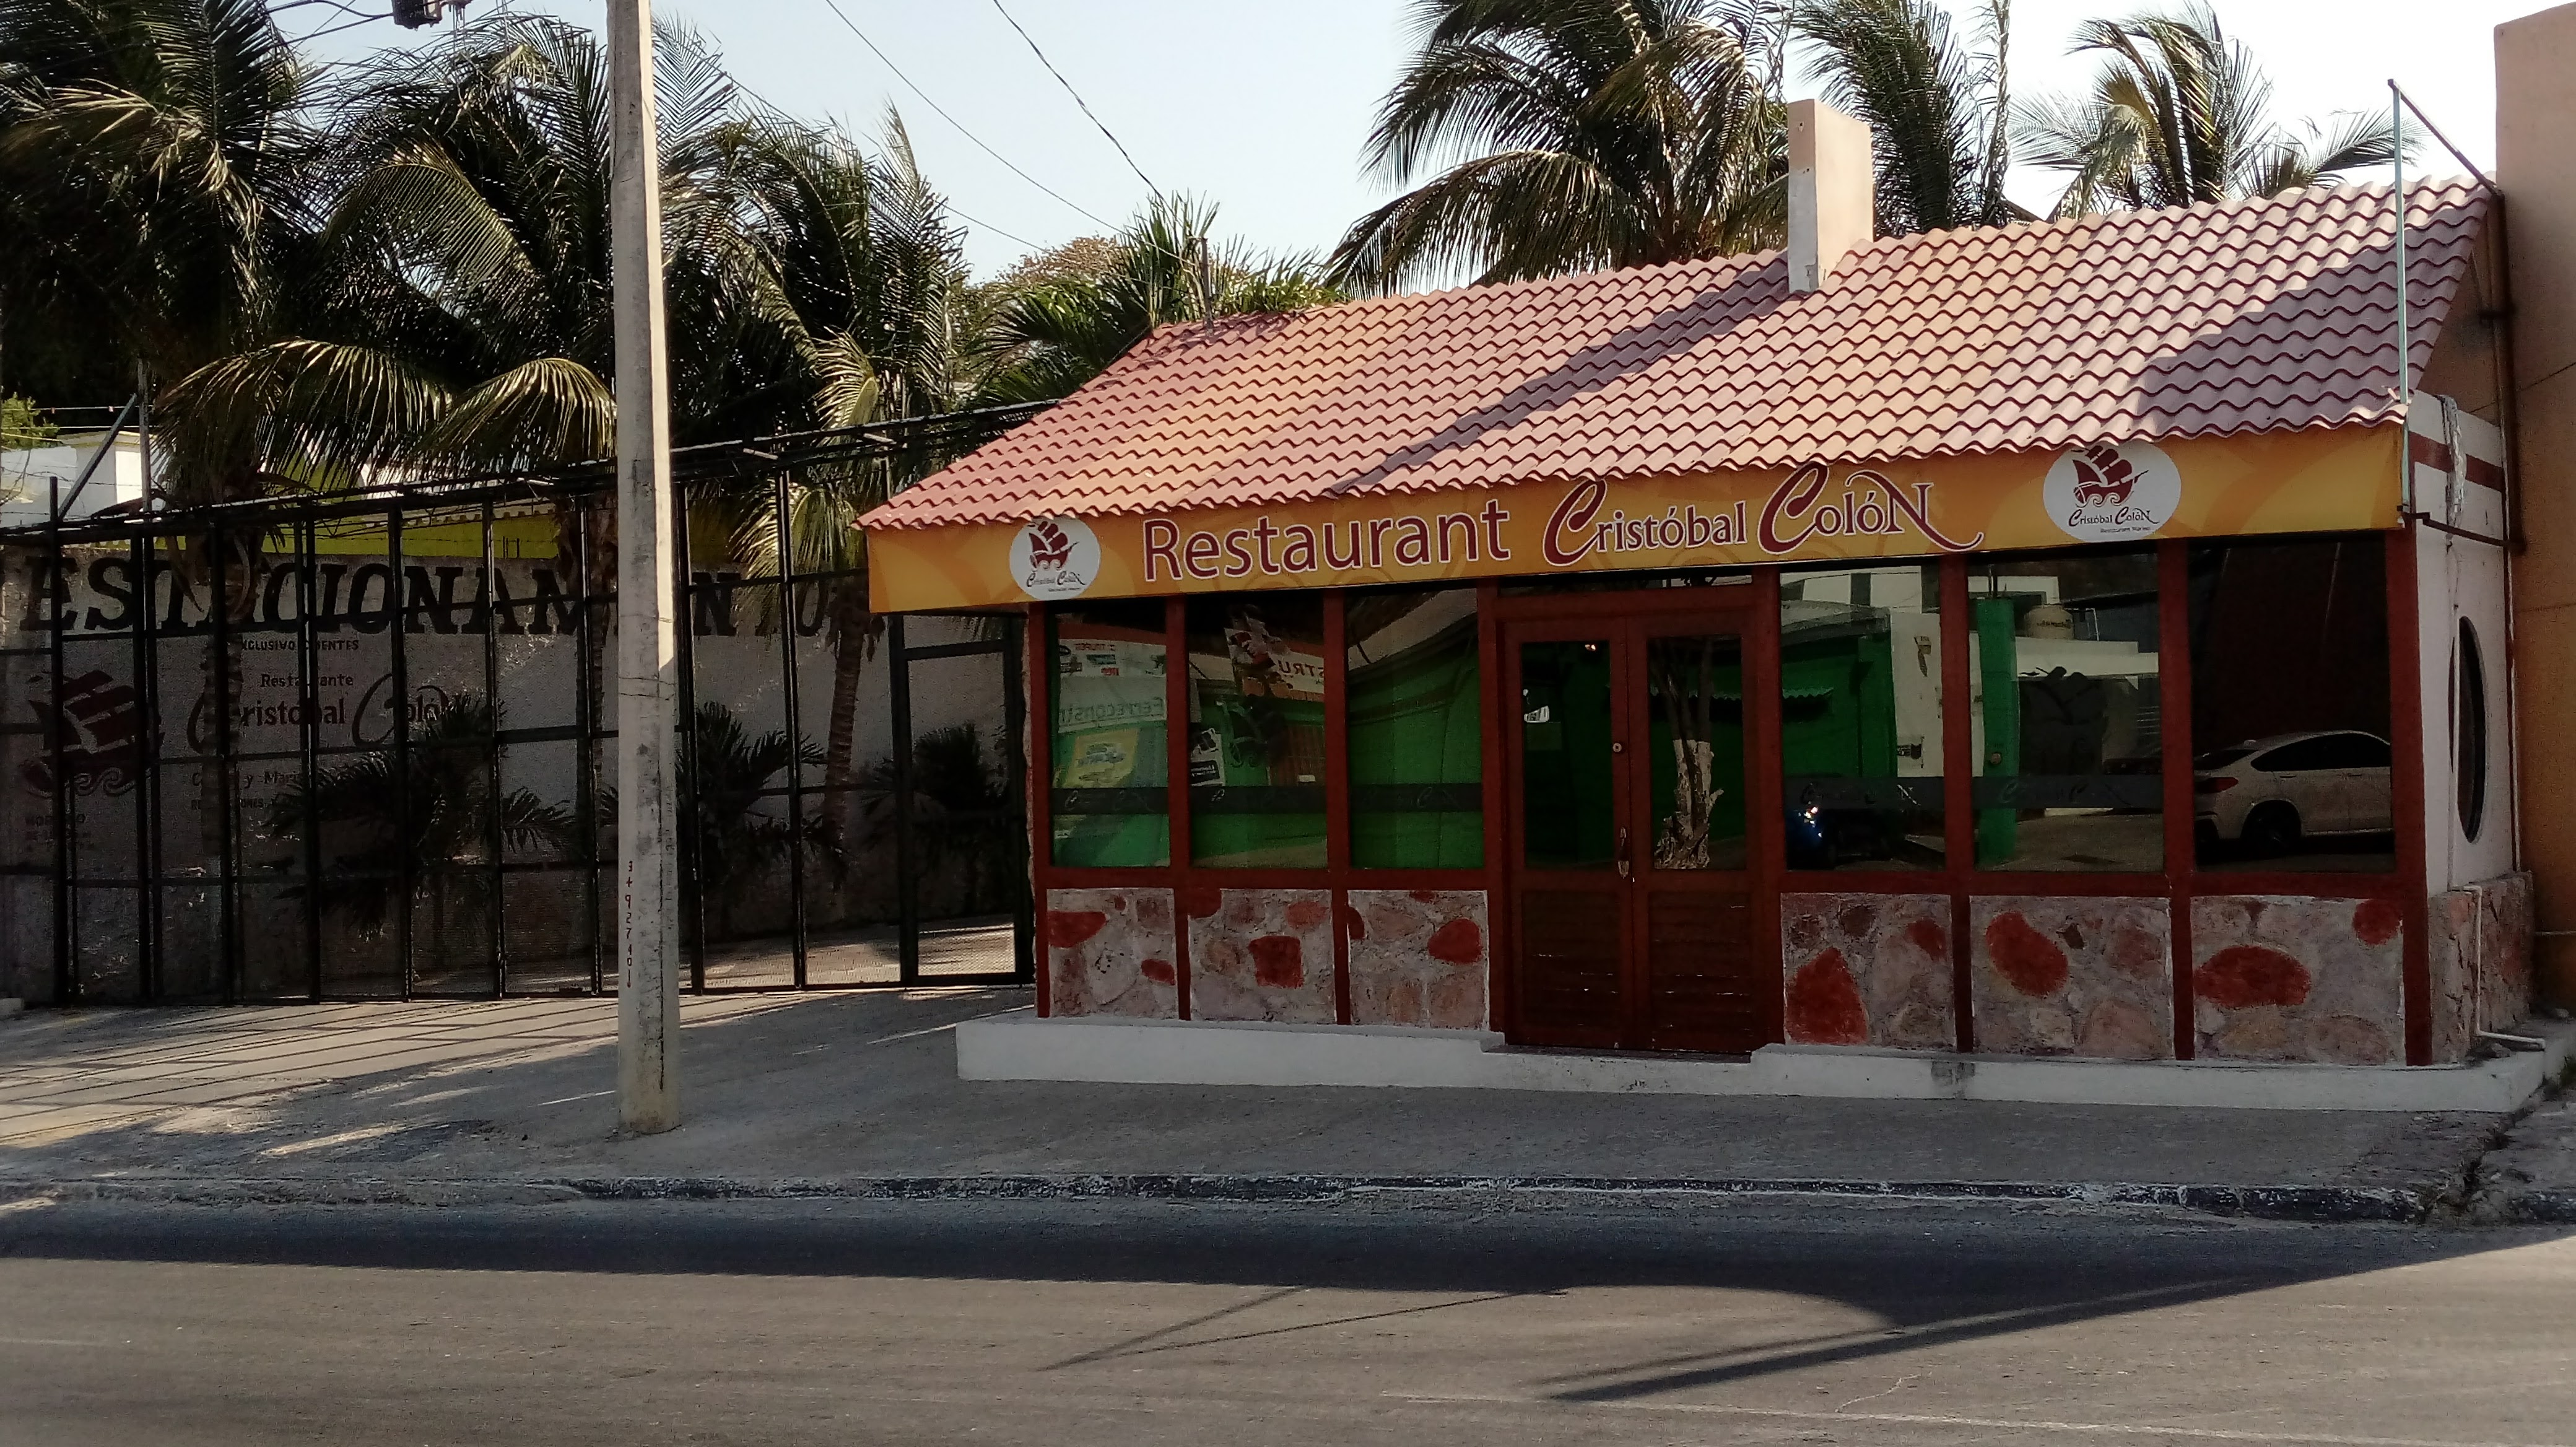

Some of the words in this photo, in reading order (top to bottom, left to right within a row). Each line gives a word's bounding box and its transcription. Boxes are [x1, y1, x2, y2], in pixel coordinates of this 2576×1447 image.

[1142, 498, 1512, 582] Restaurant
[1543, 479, 1748, 566] Cristóbal
[260, 673, 354, 687] Restaante
